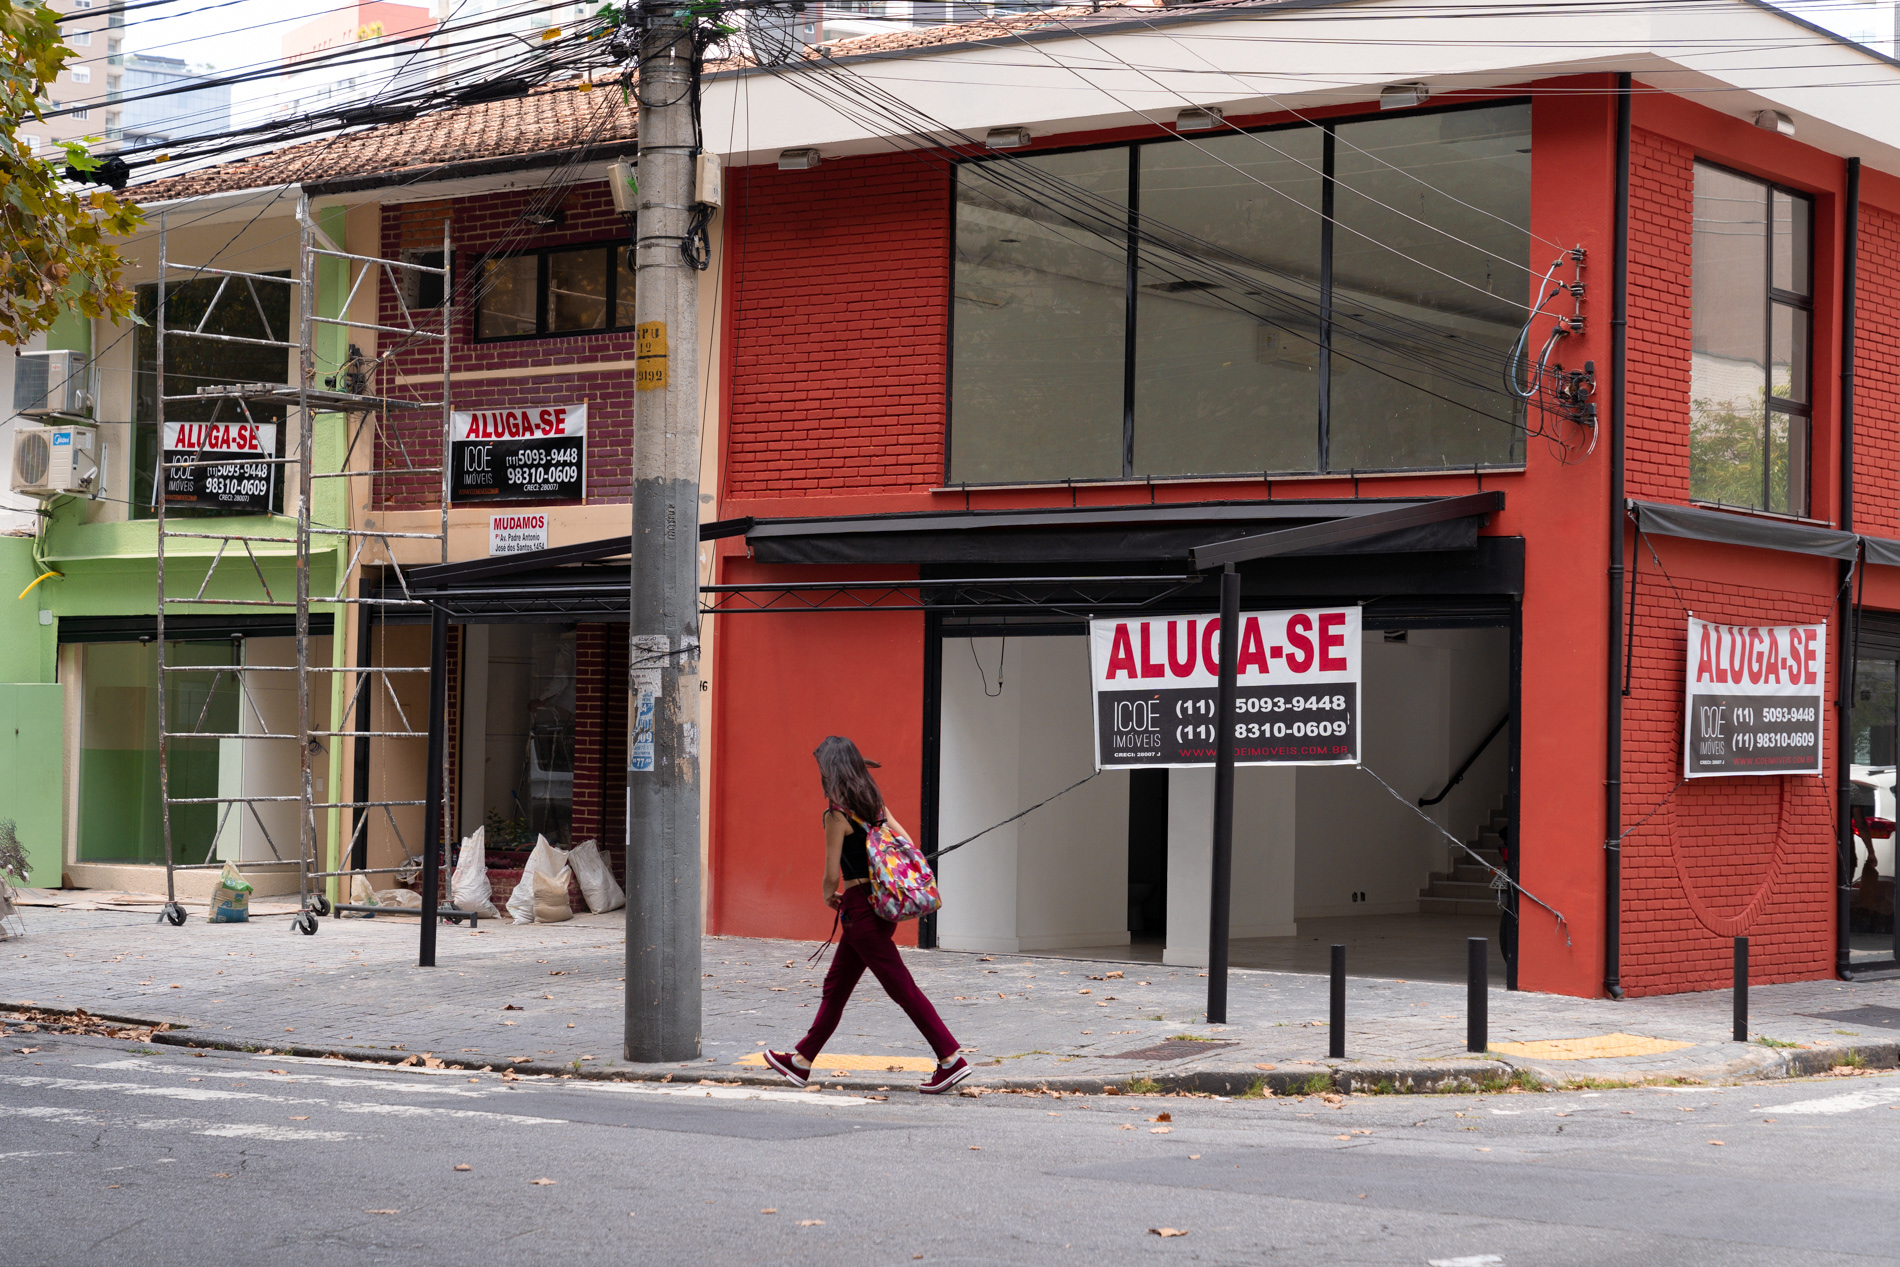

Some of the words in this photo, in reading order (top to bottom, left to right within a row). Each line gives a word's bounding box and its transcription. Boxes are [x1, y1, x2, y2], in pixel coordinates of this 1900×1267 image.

[466, 408, 566, 439] ALUGA-SE
[175, 424, 260, 451] ALUGA-SE
[464, 442, 494, 472] ICOÉ
[463, 471, 493, 485] IMÓVEIS
[507, 465, 578, 484] 98310-0609
[168, 479, 195, 492] IMÓVEIS
[205, 477, 267, 496] 98310-0609
[493, 515, 545, 531] MUDAMOS
[495, 543, 506, 552] José
[507, 543, 516, 552] dos
[507, 533, 521, 542] Padre
[1105, 612, 1348, 680] ALUGA-SE
[1696, 623, 1818, 686] ALUGA-SE
[1114, 694, 1161, 732] ICOÉ
[1175, 699, 1216, 719] (11)
[1235, 695, 1346, 714] 5093-9448
[1733, 707, 1754, 726] (11)
[1762, 707, 1815, 723] 5093-9448
[1700, 700, 1727, 738] ICOÉ
[1113, 732, 1161, 748] IMÓVEIS
[1175, 724, 1216, 744] (11)
[1234, 720, 1347, 739] 8310-0609
[1732, 732, 1754, 752] (11)
[1756, 731, 1815, 748] 98310-0609
[1700, 738, 1725, 755] IMÓVEIS
